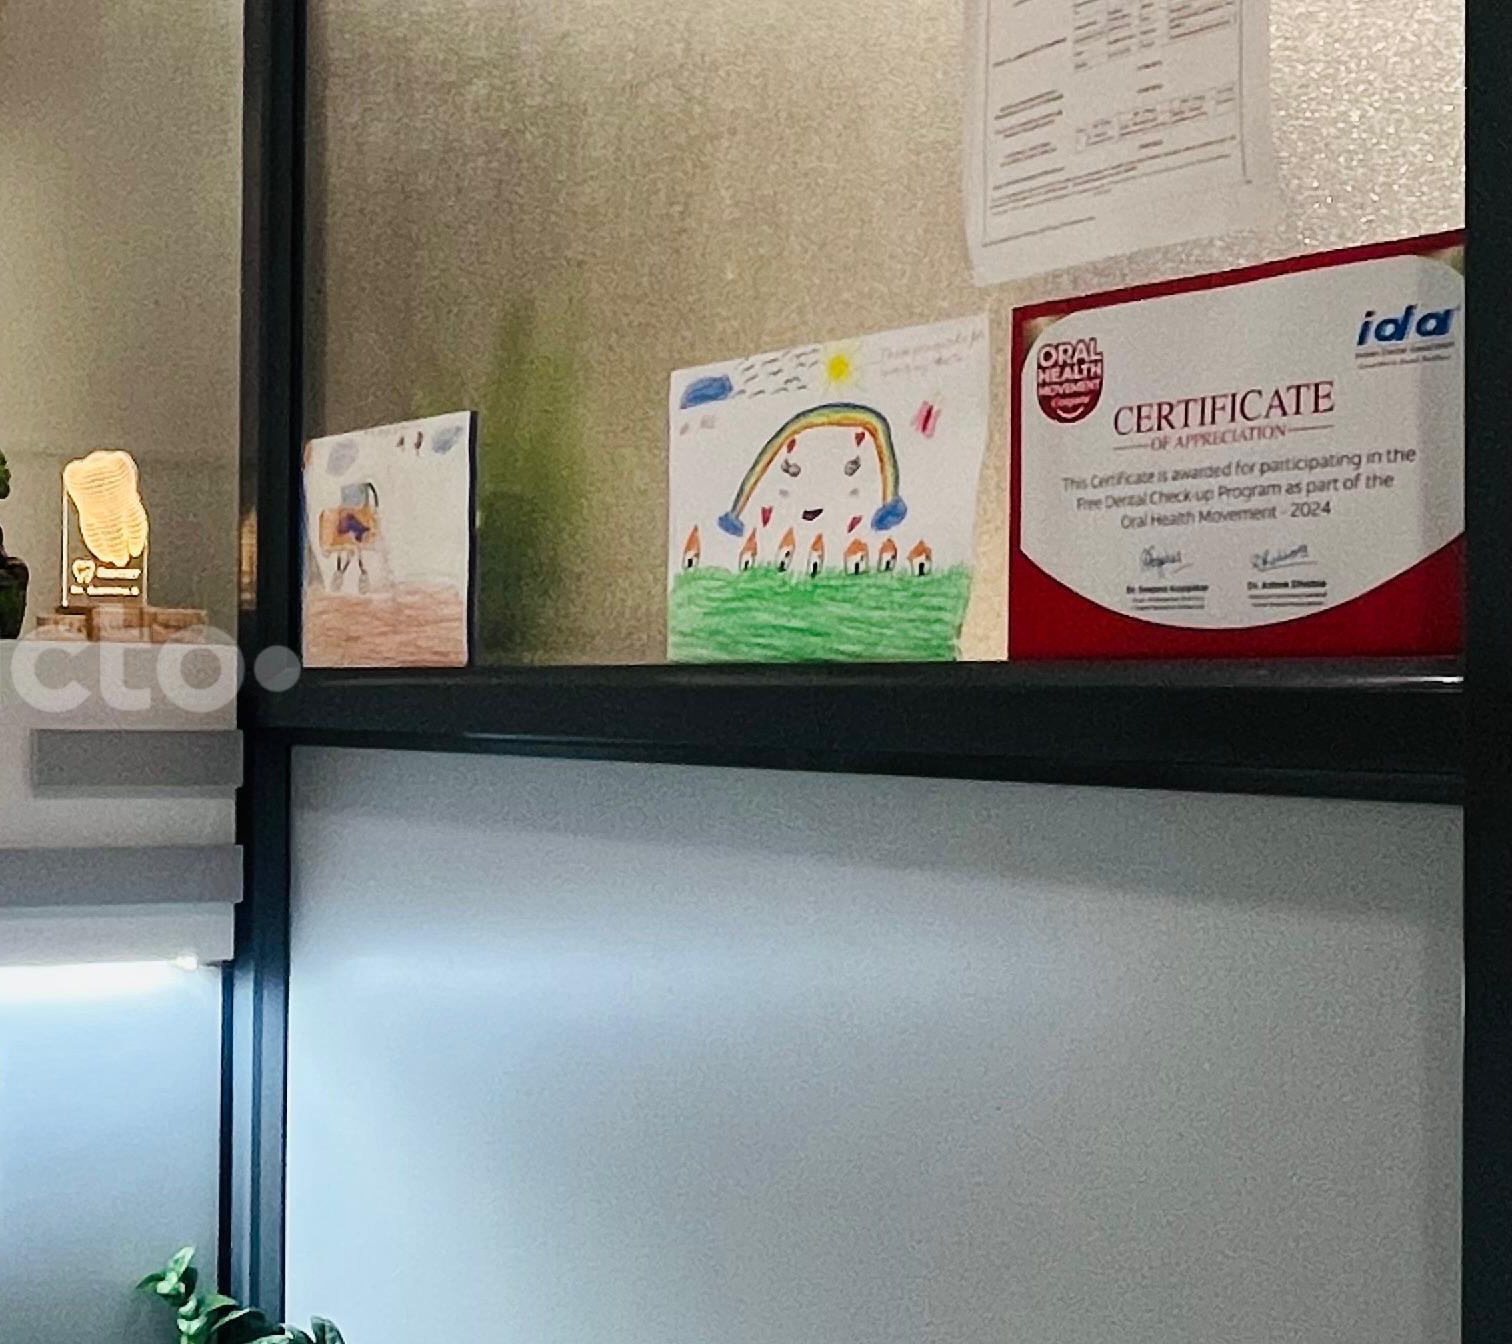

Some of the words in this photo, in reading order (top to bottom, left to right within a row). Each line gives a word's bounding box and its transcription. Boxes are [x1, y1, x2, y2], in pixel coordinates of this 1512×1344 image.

[1356, 304, 1456, 346] ida
[1039, 338, 1103, 369] ORAL
[1038, 361, 1103, 385] HEALTH
[1113, 380, 1335, 436] CERTIFICATE
[1150, 436, 1170, 452] OF
[1175, 425, 1287, 450] APPRECIATION
[1062, 477, 1088, 492] This
[1090, 470, 1155, 490] Certificate
[1157, 471, 1168, 484] is
[1171, 461, 1232, 482] awarded
[1234, 460, 1255, 476] for
[1259, 453, 1362, 477] participating
[1366, 451, 1383, 464] in
[1386, 448, 1417, 464] the
[1076, 496, 1102, 512] Free
[1104, 491, 1148, 509] Dental
[1217, 482, 1282, 504] Program
[1285, 480, 1302, 495] as
[1306, 478, 1339, 497] part
[1342, 473, 1361, 490] of
[1364, 473, 1395, 490] the
[1120, 511, 1148, 529] Oral
[1150, 510, 1195, 527] Health
[1198, 506, 1277, 525] Movement
[1290, 500, 1332, 518] 2024
